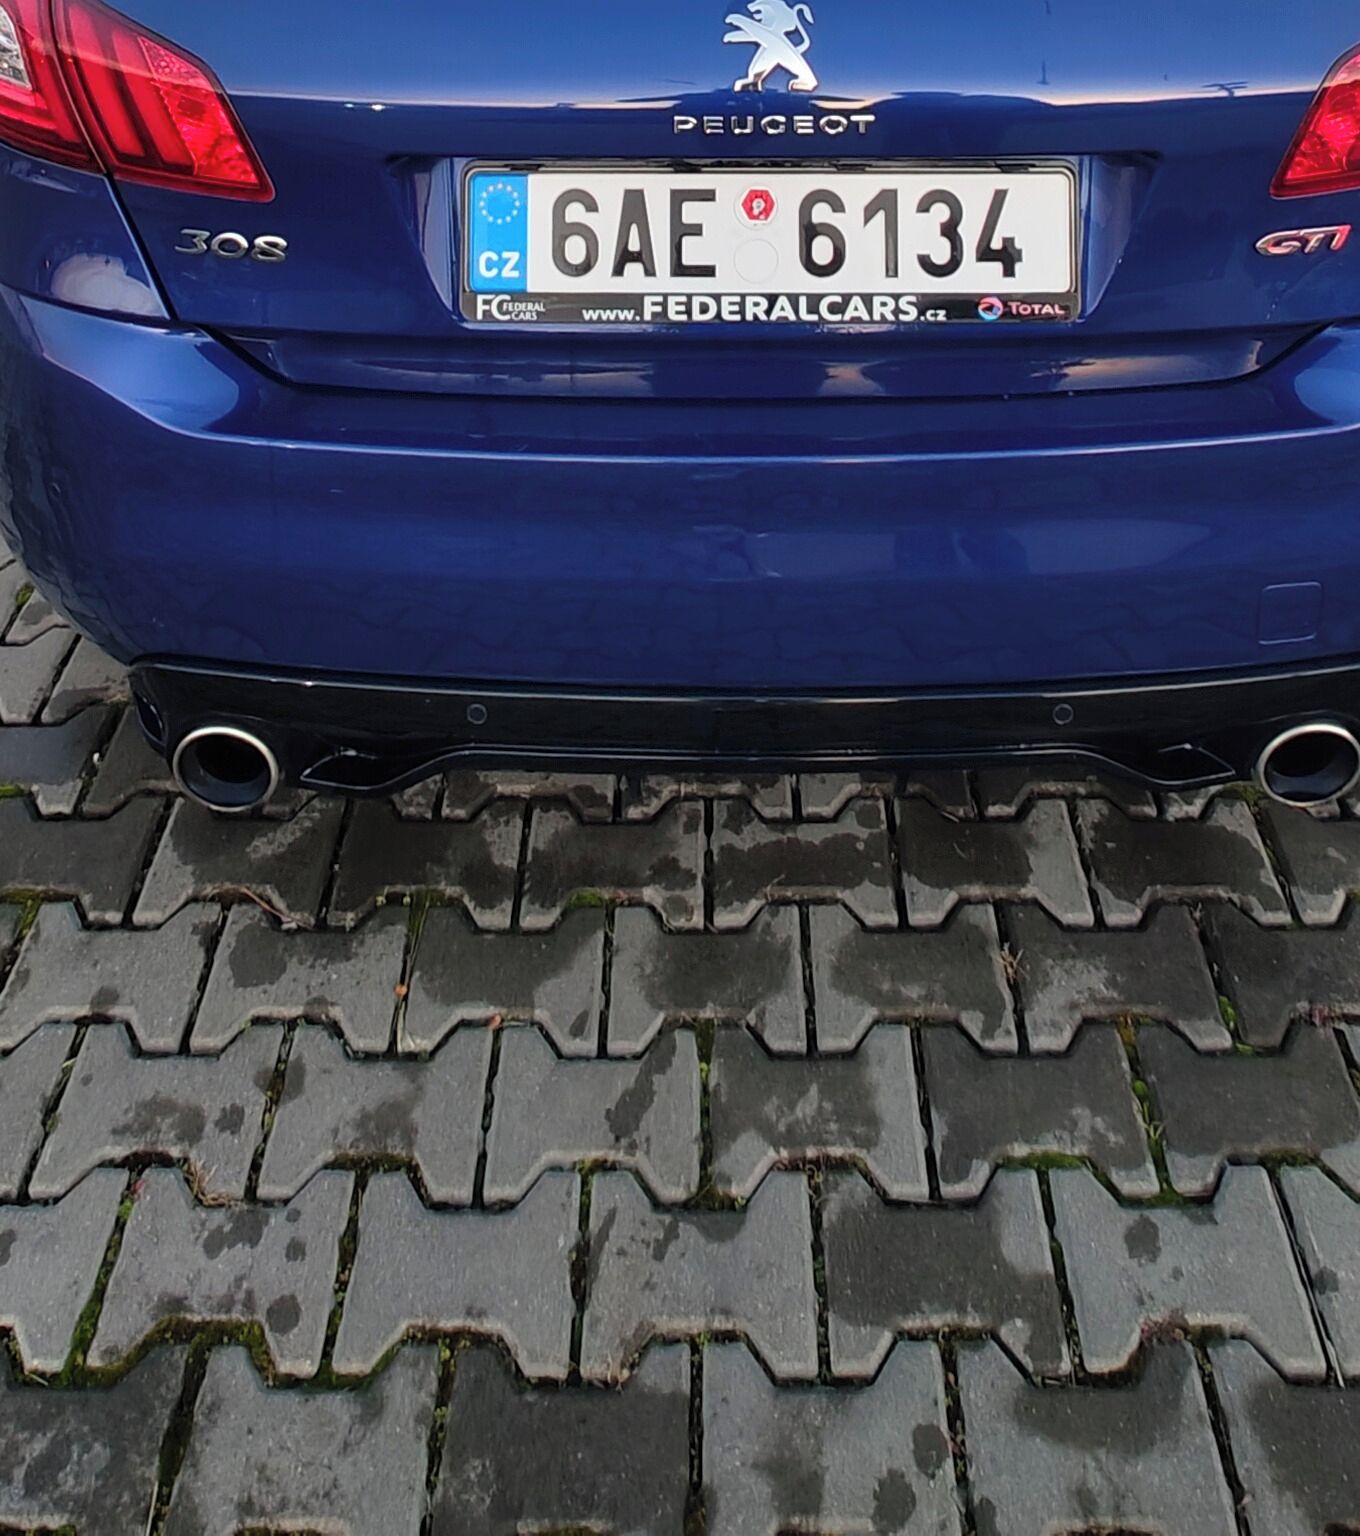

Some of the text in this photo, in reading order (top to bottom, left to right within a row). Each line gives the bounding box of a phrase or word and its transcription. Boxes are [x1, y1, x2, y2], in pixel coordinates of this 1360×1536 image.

[674, 115, 876, 134] PEUGEOT
[174, 228, 288, 261] 308
[552, 188, 1023, 278] 6AE 6134
[478, 251, 520, 278] CZ
[476, 294, 512, 321] FC
[502, 301, 546, 313] FEDERAL
[511, 312, 538, 321] CARS
[582, 294, 947, 322] www.FEDERALCARS.cz
